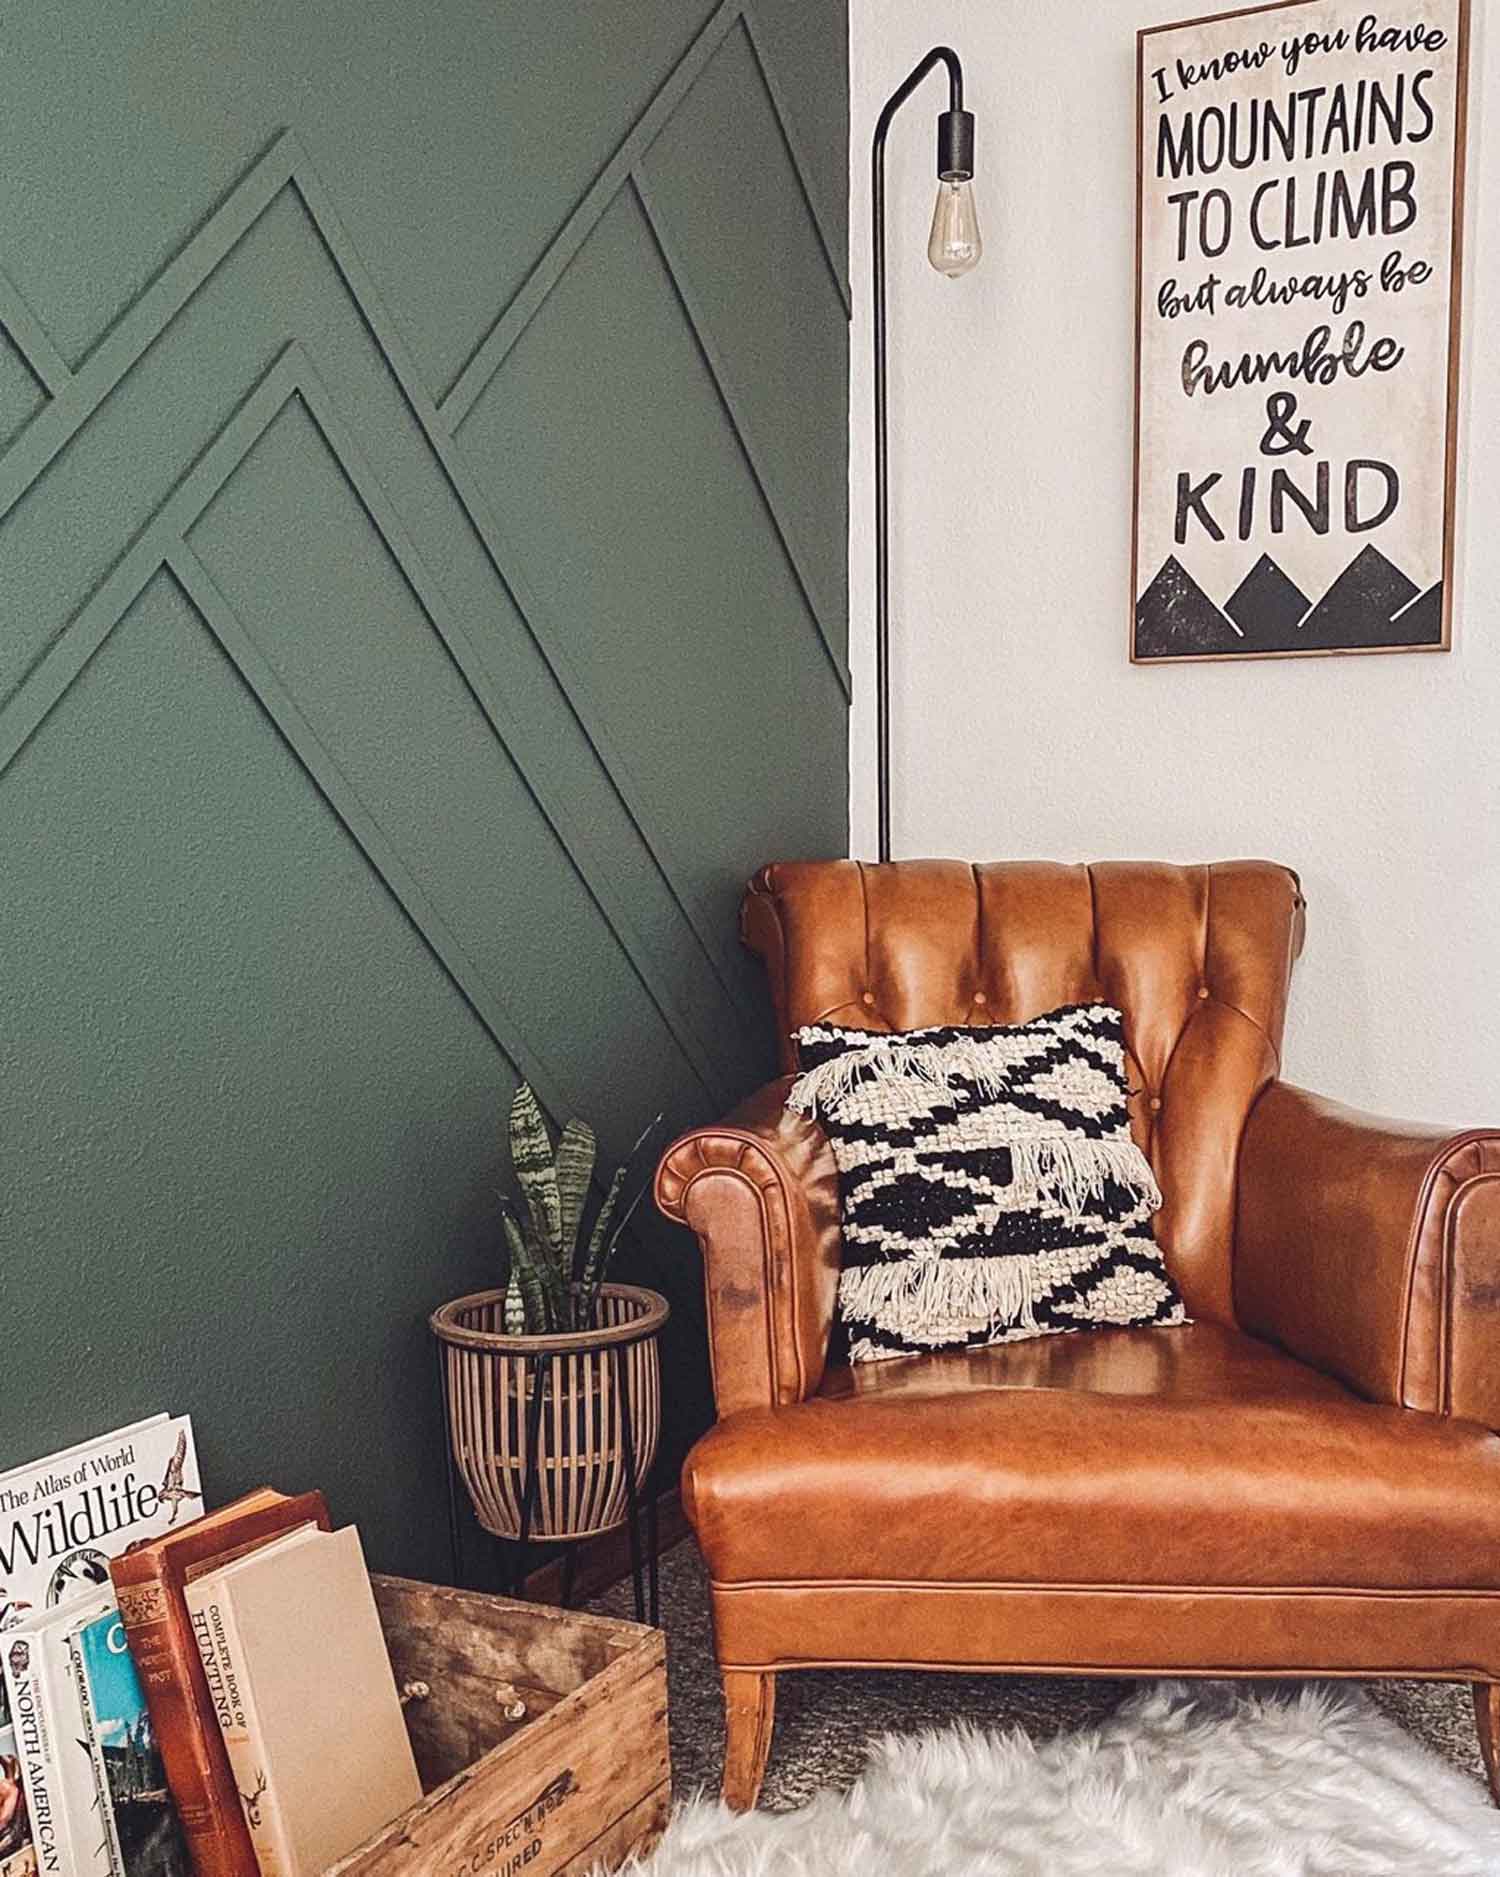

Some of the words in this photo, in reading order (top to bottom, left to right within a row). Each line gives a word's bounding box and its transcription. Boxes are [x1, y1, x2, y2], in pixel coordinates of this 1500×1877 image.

[1151, 67, 1174, 103] I
[1176, 42, 1276, 89] know
[1282, 29, 1349, 76] you
[1355, 14, 1448, 53] have
[1157, 70, 1433, 179] MOUNTAINS
[1168, 188, 1232, 261] TO
[1250, 160, 1417, 250] CLIMB
[1158, 274, 1221, 319] but
[1225, 267, 1373, 314] always
[1380, 251, 1432, 292] be
[1181, 320, 1404, 397] humble
[1260, 391, 1314, 456] &
[1174, 459, 1400, 544] KIND
[0, 1489, 29, 1512] The
[32, 1475, 71, 1500] Atlas
[73, 1462, 87, 1485] of
[90, 1445, 136, 1476] World
[0, 1473, 159, 1575] Wildlife
[191, 1609, 233, 1728] HUNTING
[209, 1605, 232, 1671] COMPLETE
[225, 1674, 242, 1708] BOOK
[235, 1712, 248, 1728] OF
[15, 1680, 41, 1755] NORTH
[28, 1761, 59, 1871] AMERICAN
